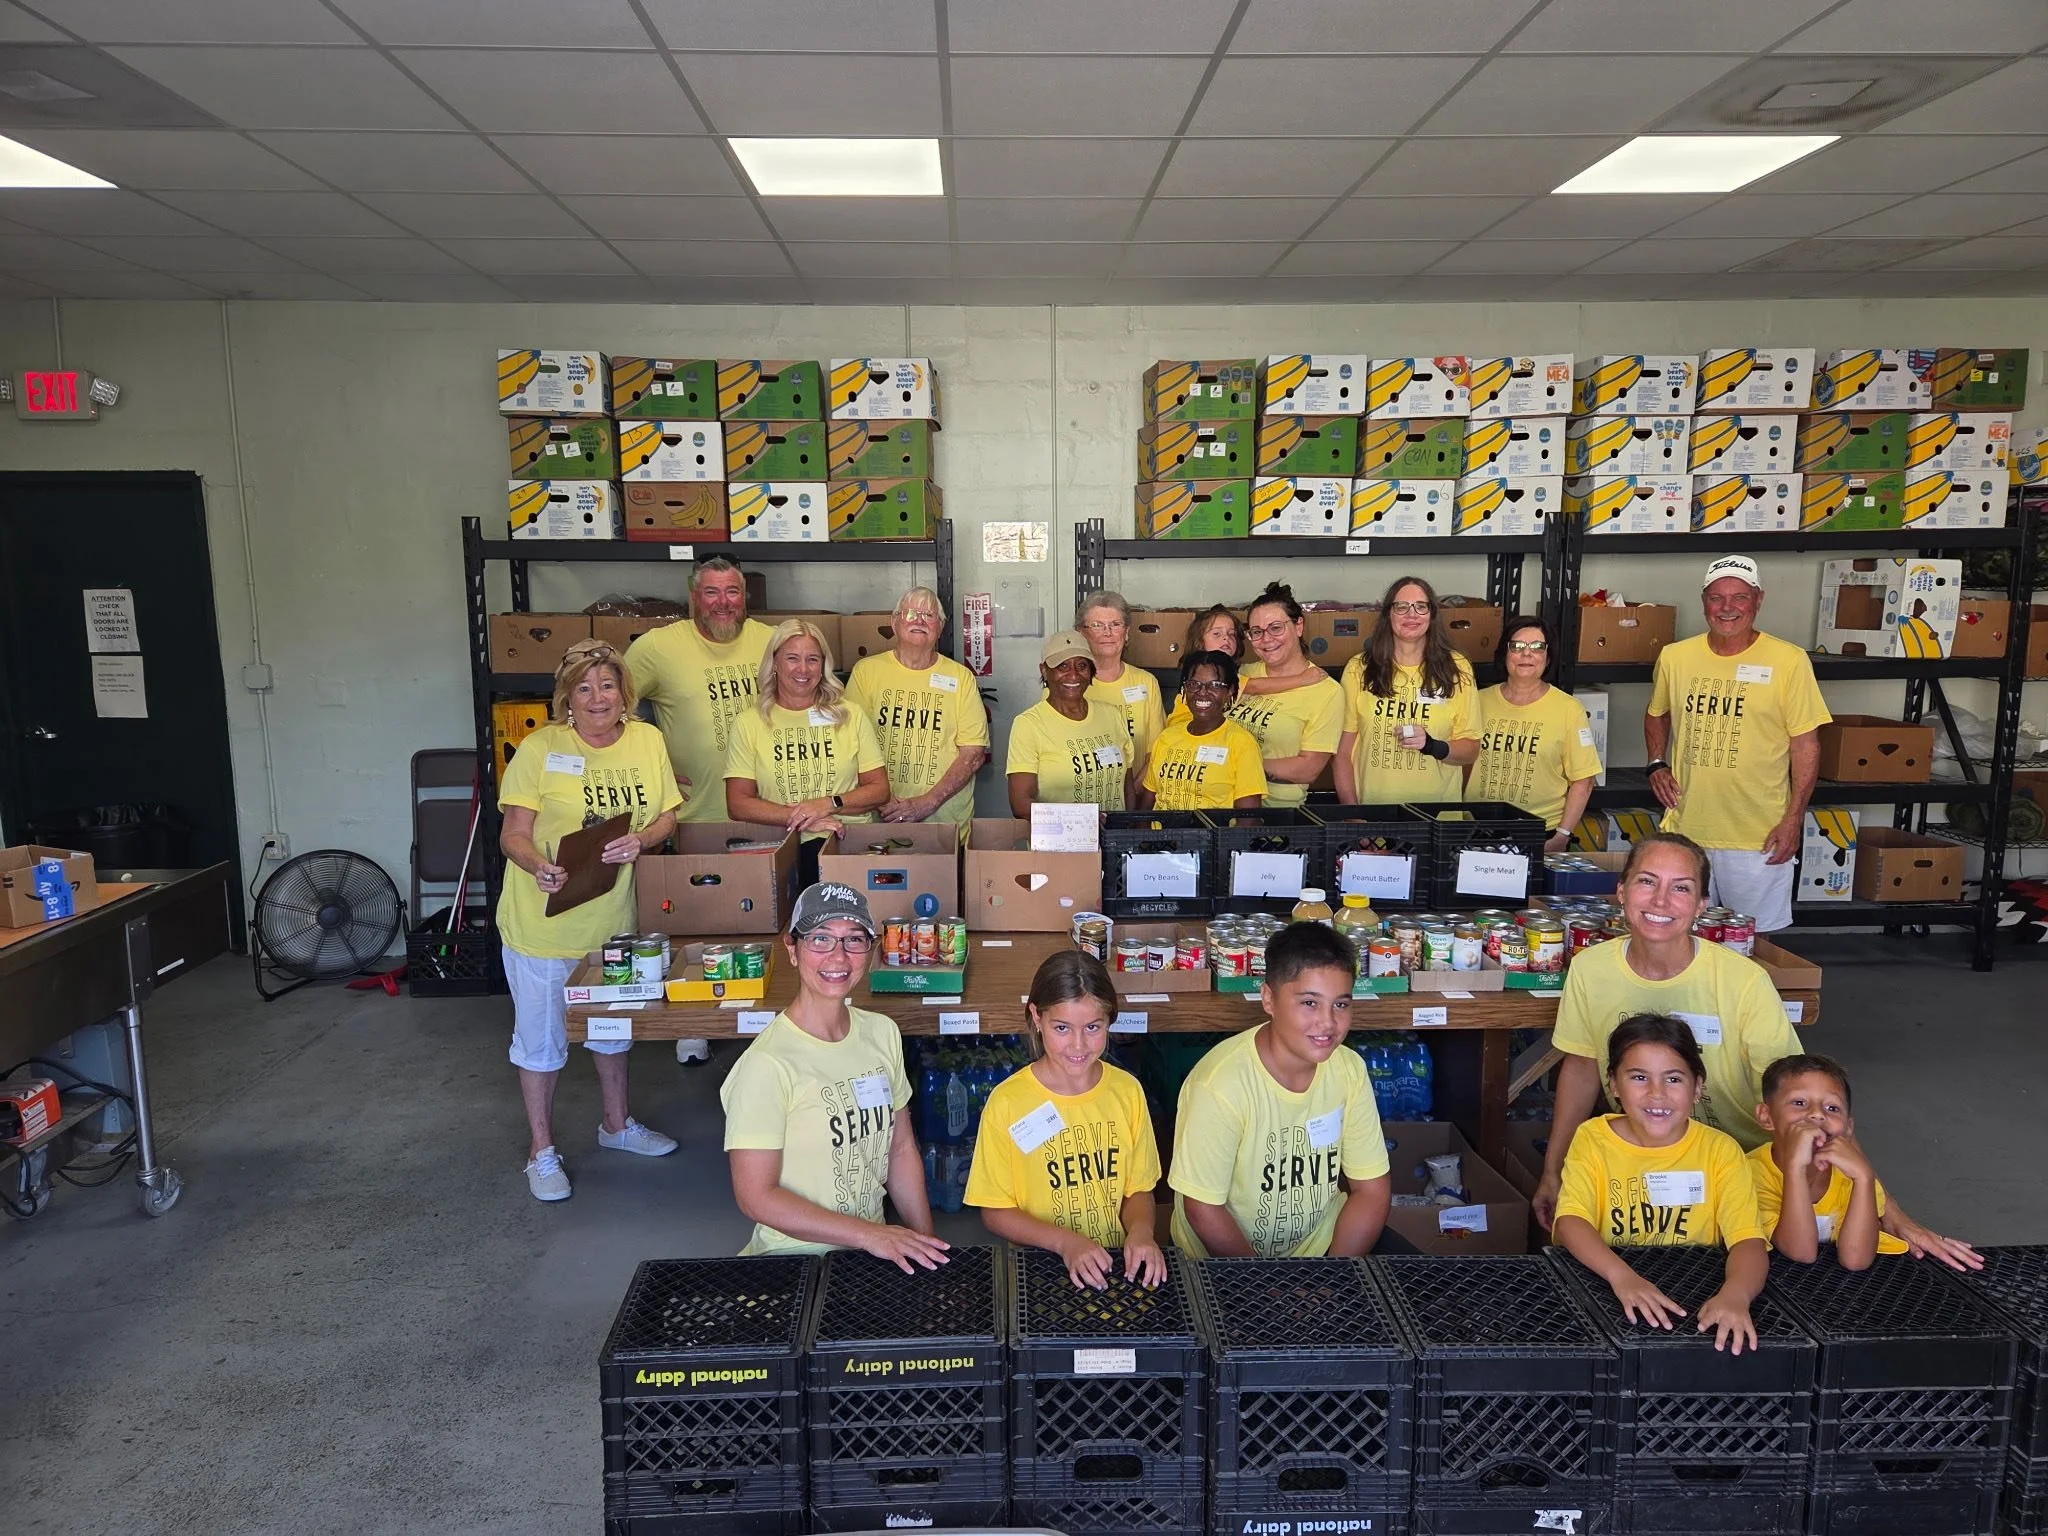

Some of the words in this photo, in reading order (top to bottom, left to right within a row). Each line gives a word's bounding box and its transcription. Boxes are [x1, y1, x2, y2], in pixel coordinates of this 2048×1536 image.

[1547, 371, 1569, 382] ME4
[25, 371, 79, 412] EXIT
[1988, 428, 2009, 440] ME4
[966, 600, 988, 610] FIRE
[704, 663, 759, 684] SERVE
[708, 677, 760, 700] SERV
[1689, 677, 1749, 699] SERVE
[882, 688, 944, 712] SERVE
[1375, 700, 1431, 718] SERVE
[1686, 694, 1744, 716] SERVE
[878, 706, 942, 731] SERVE
[1485, 718, 1543, 738] SERVE
[774, 726, 832, 745] SERVE
[877, 726, 940, 748] SERVE
[1482, 733, 1540, 754] SERVE
[774, 741, 834, 761] SERVE
[881, 744, 939, 766] ERVE
[1371, 749, 1426, 770] SERVE
[1480, 750, 1536, 771] SERVE
[775, 757, 836, 778] SERVE
[886, 762, 936, 785] ERVE
[1072, 752, 1122, 774] SER
[1160, 762, 1207, 782] SERVE
[582, 768, 643, 788] SERVE
[584, 785, 647, 807] SERVE
[1144, 873, 1156, 882] Dry
[1260, 872, 1276, 882] Jelly
[1352, 874, 1376, 882] Peanut
[1378, 874, 1400, 883] Butter
[1474, 865, 1495, 875] Single
[1497, 867, 1516, 875] Meat
[46, 897, 60, 920] 8-11
[1141, 904, 1172, 912] RECYCLE
[594, 1024, 620, 1032] Desserts
[962, 1018, 978, 1026] Pasta
[1375, 1076, 1420, 1098] niagara
[830, 1104, 894, 1148] SERVE
[1044, 1121, 1120, 1161] SERVE
[1265, 1126, 1338, 1164] SER
[1047, 1148, 1120, 1189] SERVE
[1261, 1151, 1338, 1192] SERVE
[1051, 1176, 1118, 1217] SERVE
[1611, 1202, 1691, 1236] SERVE
[844, 1358, 894, 1376] dairy
[900, 1357, 974, 1375] national
[636, 1370, 686, 1388] dairy
[691, 1368, 768, 1387] national
[1242, 1520, 1290, 1536] dairy
[1297, 1520, 1372, 1536] national
